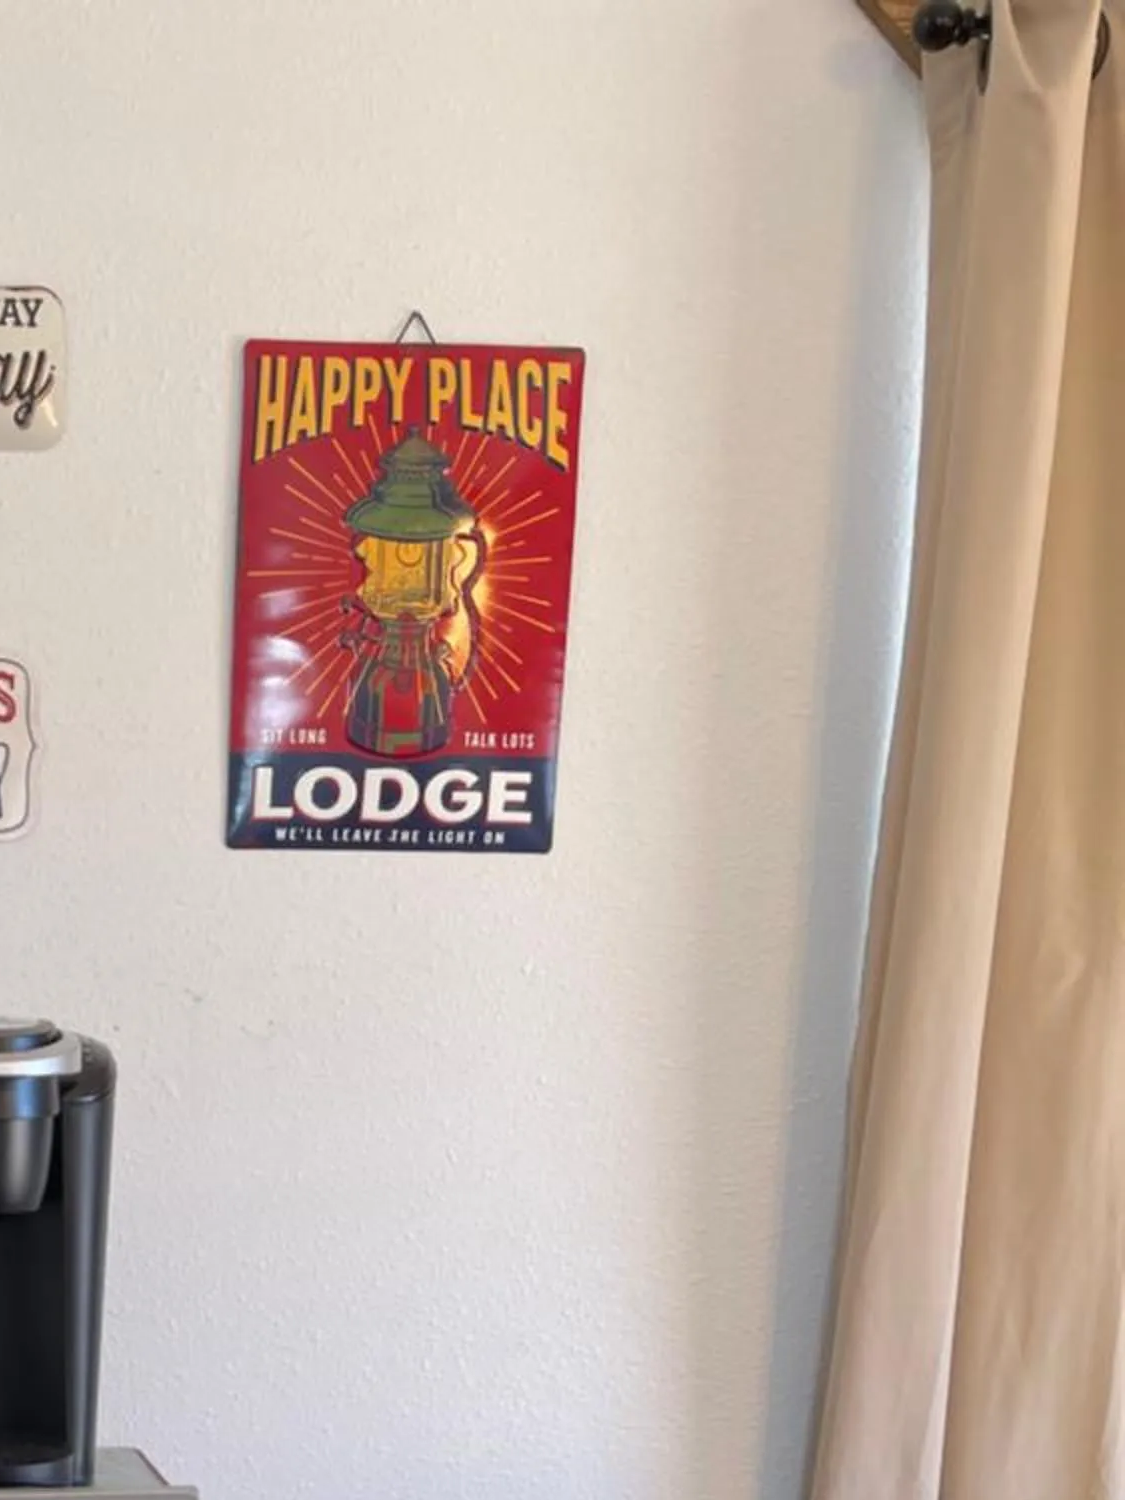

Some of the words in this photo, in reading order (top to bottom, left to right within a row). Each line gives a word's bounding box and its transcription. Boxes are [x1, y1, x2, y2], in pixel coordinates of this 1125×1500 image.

[252, 354, 414, 463] HAPPY
[426, 356, 572, 473] PLACE
[464, 731, 496, 748] TALK
[502, 732, 534, 750] LOTS
[251, 765, 533, 824] LODGE
[275, 827, 323, 841] WE'LL
[331, 828, 382, 842] LEAVE
[387, 829, 421, 843] THE
[427, 830, 475, 844] LIGHT
[482, 831, 506, 844] ON
